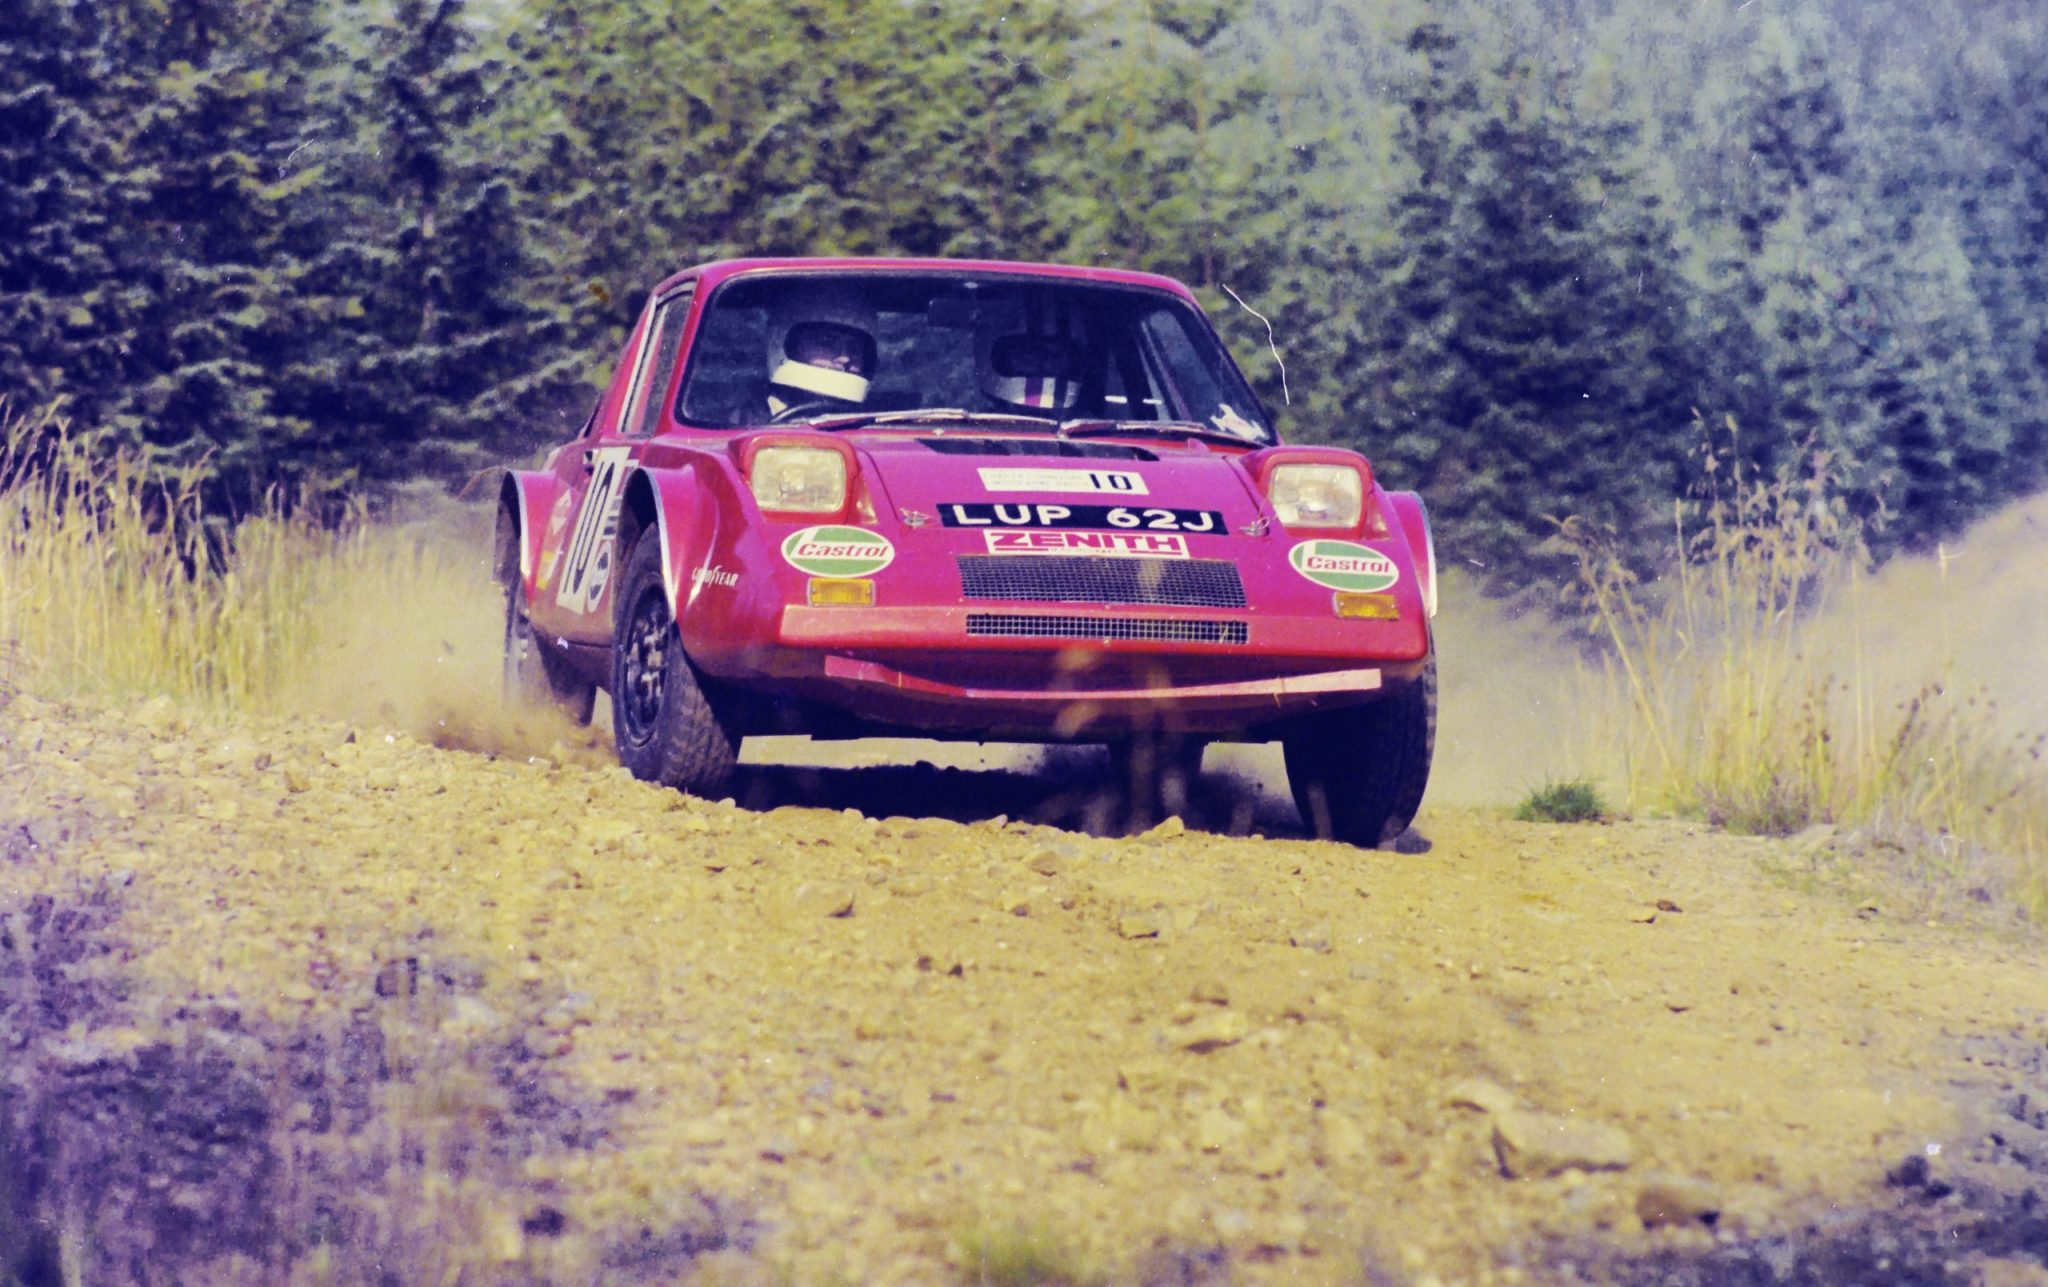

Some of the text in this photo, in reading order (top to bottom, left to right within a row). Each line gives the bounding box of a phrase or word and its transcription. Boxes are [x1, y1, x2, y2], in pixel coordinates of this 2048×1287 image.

[1089, 473, 1133, 490] 10
[953, 504, 1214, 531] LUP 62J
[563, 461, 615, 594] 10
[990, 532, 1182, 550] ZENITH
[798, 543, 889, 557] Castrol
[1307, 556, 1390, 573] Castrol
